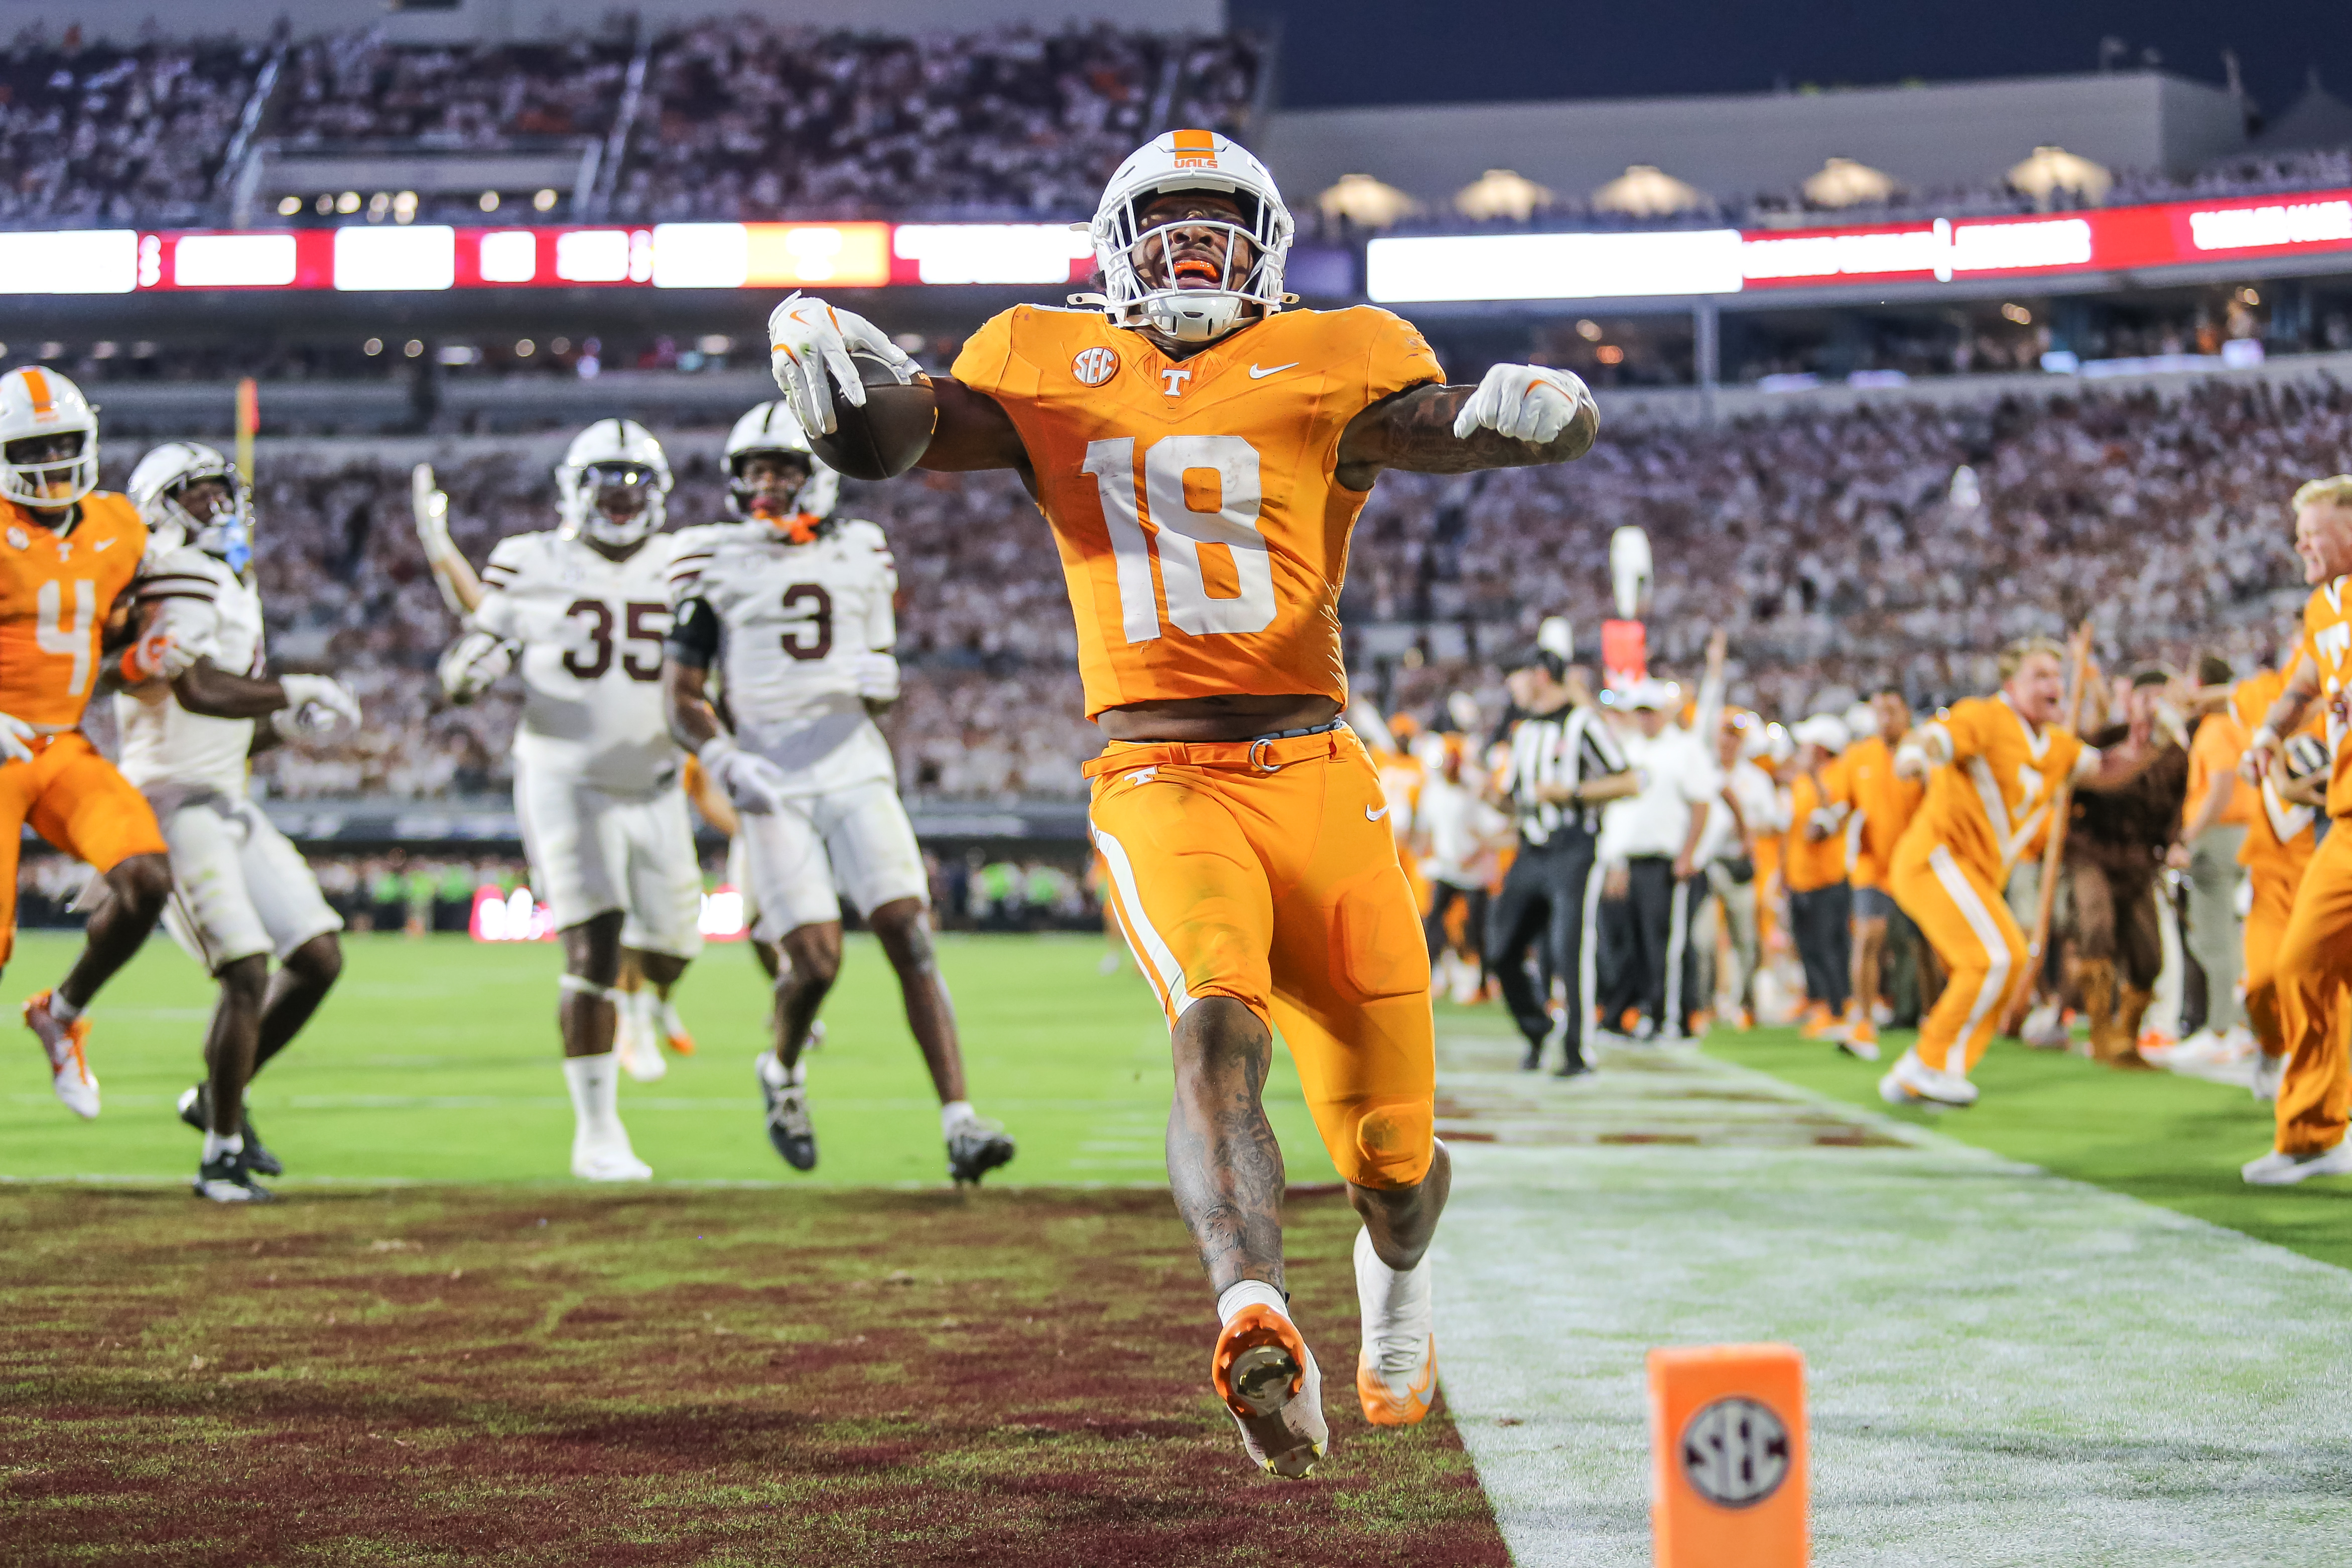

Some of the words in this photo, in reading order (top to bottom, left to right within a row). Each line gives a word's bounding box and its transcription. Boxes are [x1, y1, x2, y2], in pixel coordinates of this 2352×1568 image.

[1073, 347, 1115, 384] SEC
[1161, 368, 1191, 397] T
[1082, 435, 1277, 644] 18
[37, 579, 96, 696] 4
[563, 599, 671, 681] 35
[781, 583, 831, 660] 3
[1686, 1400, 1787, 1500] SEC
